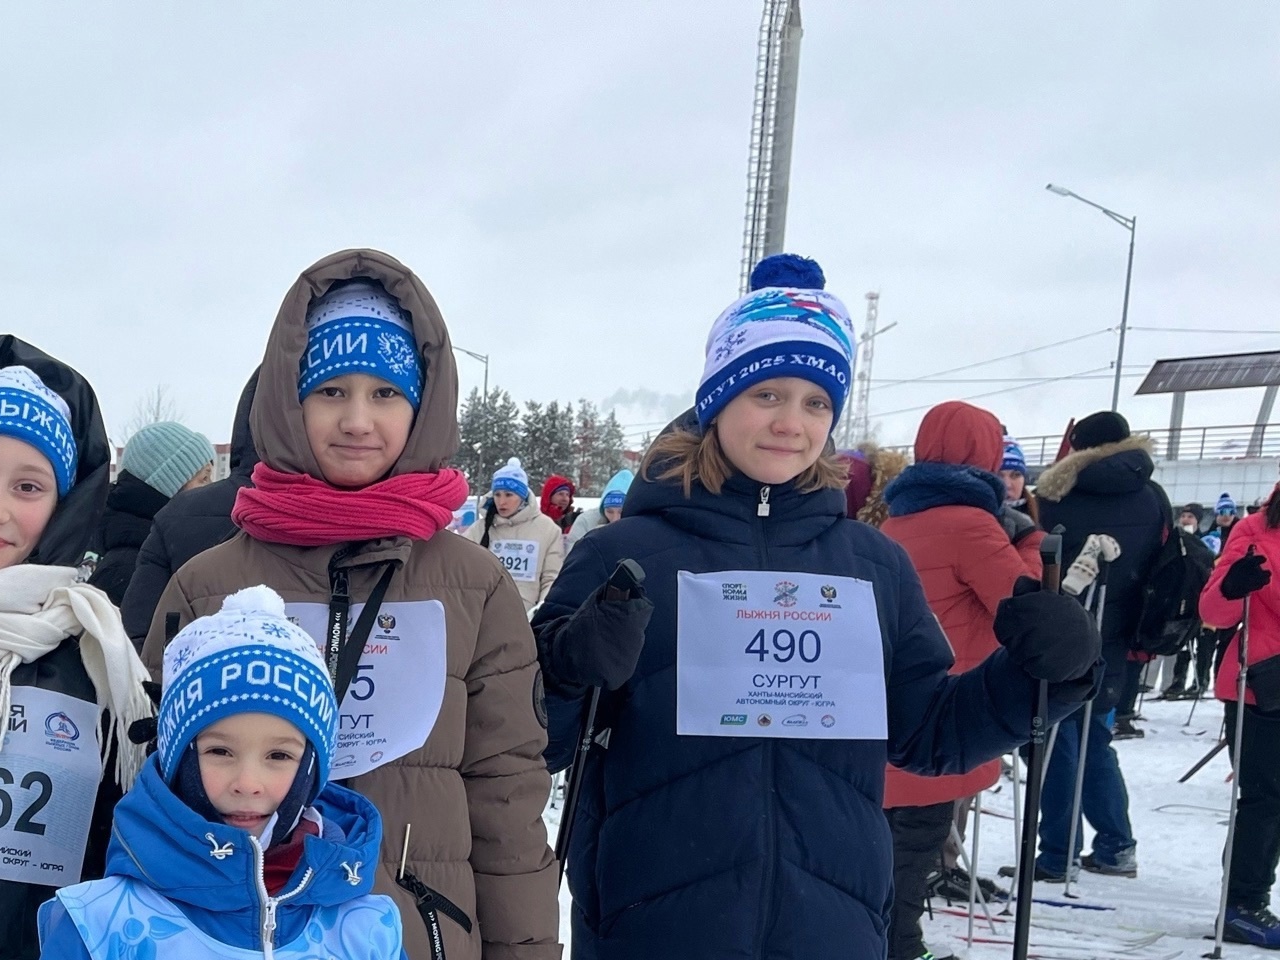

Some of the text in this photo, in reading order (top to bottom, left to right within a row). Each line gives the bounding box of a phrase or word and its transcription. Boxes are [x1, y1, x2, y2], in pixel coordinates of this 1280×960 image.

[739, 354, 786, 379] 2025
[736, 609, 832, 621] ЛЫЖНЯ РОССИИ
[331, 622, 341, 652] MOVING
[744, 628, 822, 663] 490
[752, 674, 822, 689] СУРГУТ
[221, 660, 333, 732] РОССИИ
[736, 698, 786, 706] АВТОНОМНЫЙ
[748, 691, 823, 699] ХАНТЫ-МАНСИЙСКИЙ
[366, 738, 387, 747] ЮГРА
[2, 853, 30, 867] ОКРУГ
[40, 862, 64, 872] ЮГРА
[431, 922, 441, 953] MOVING
